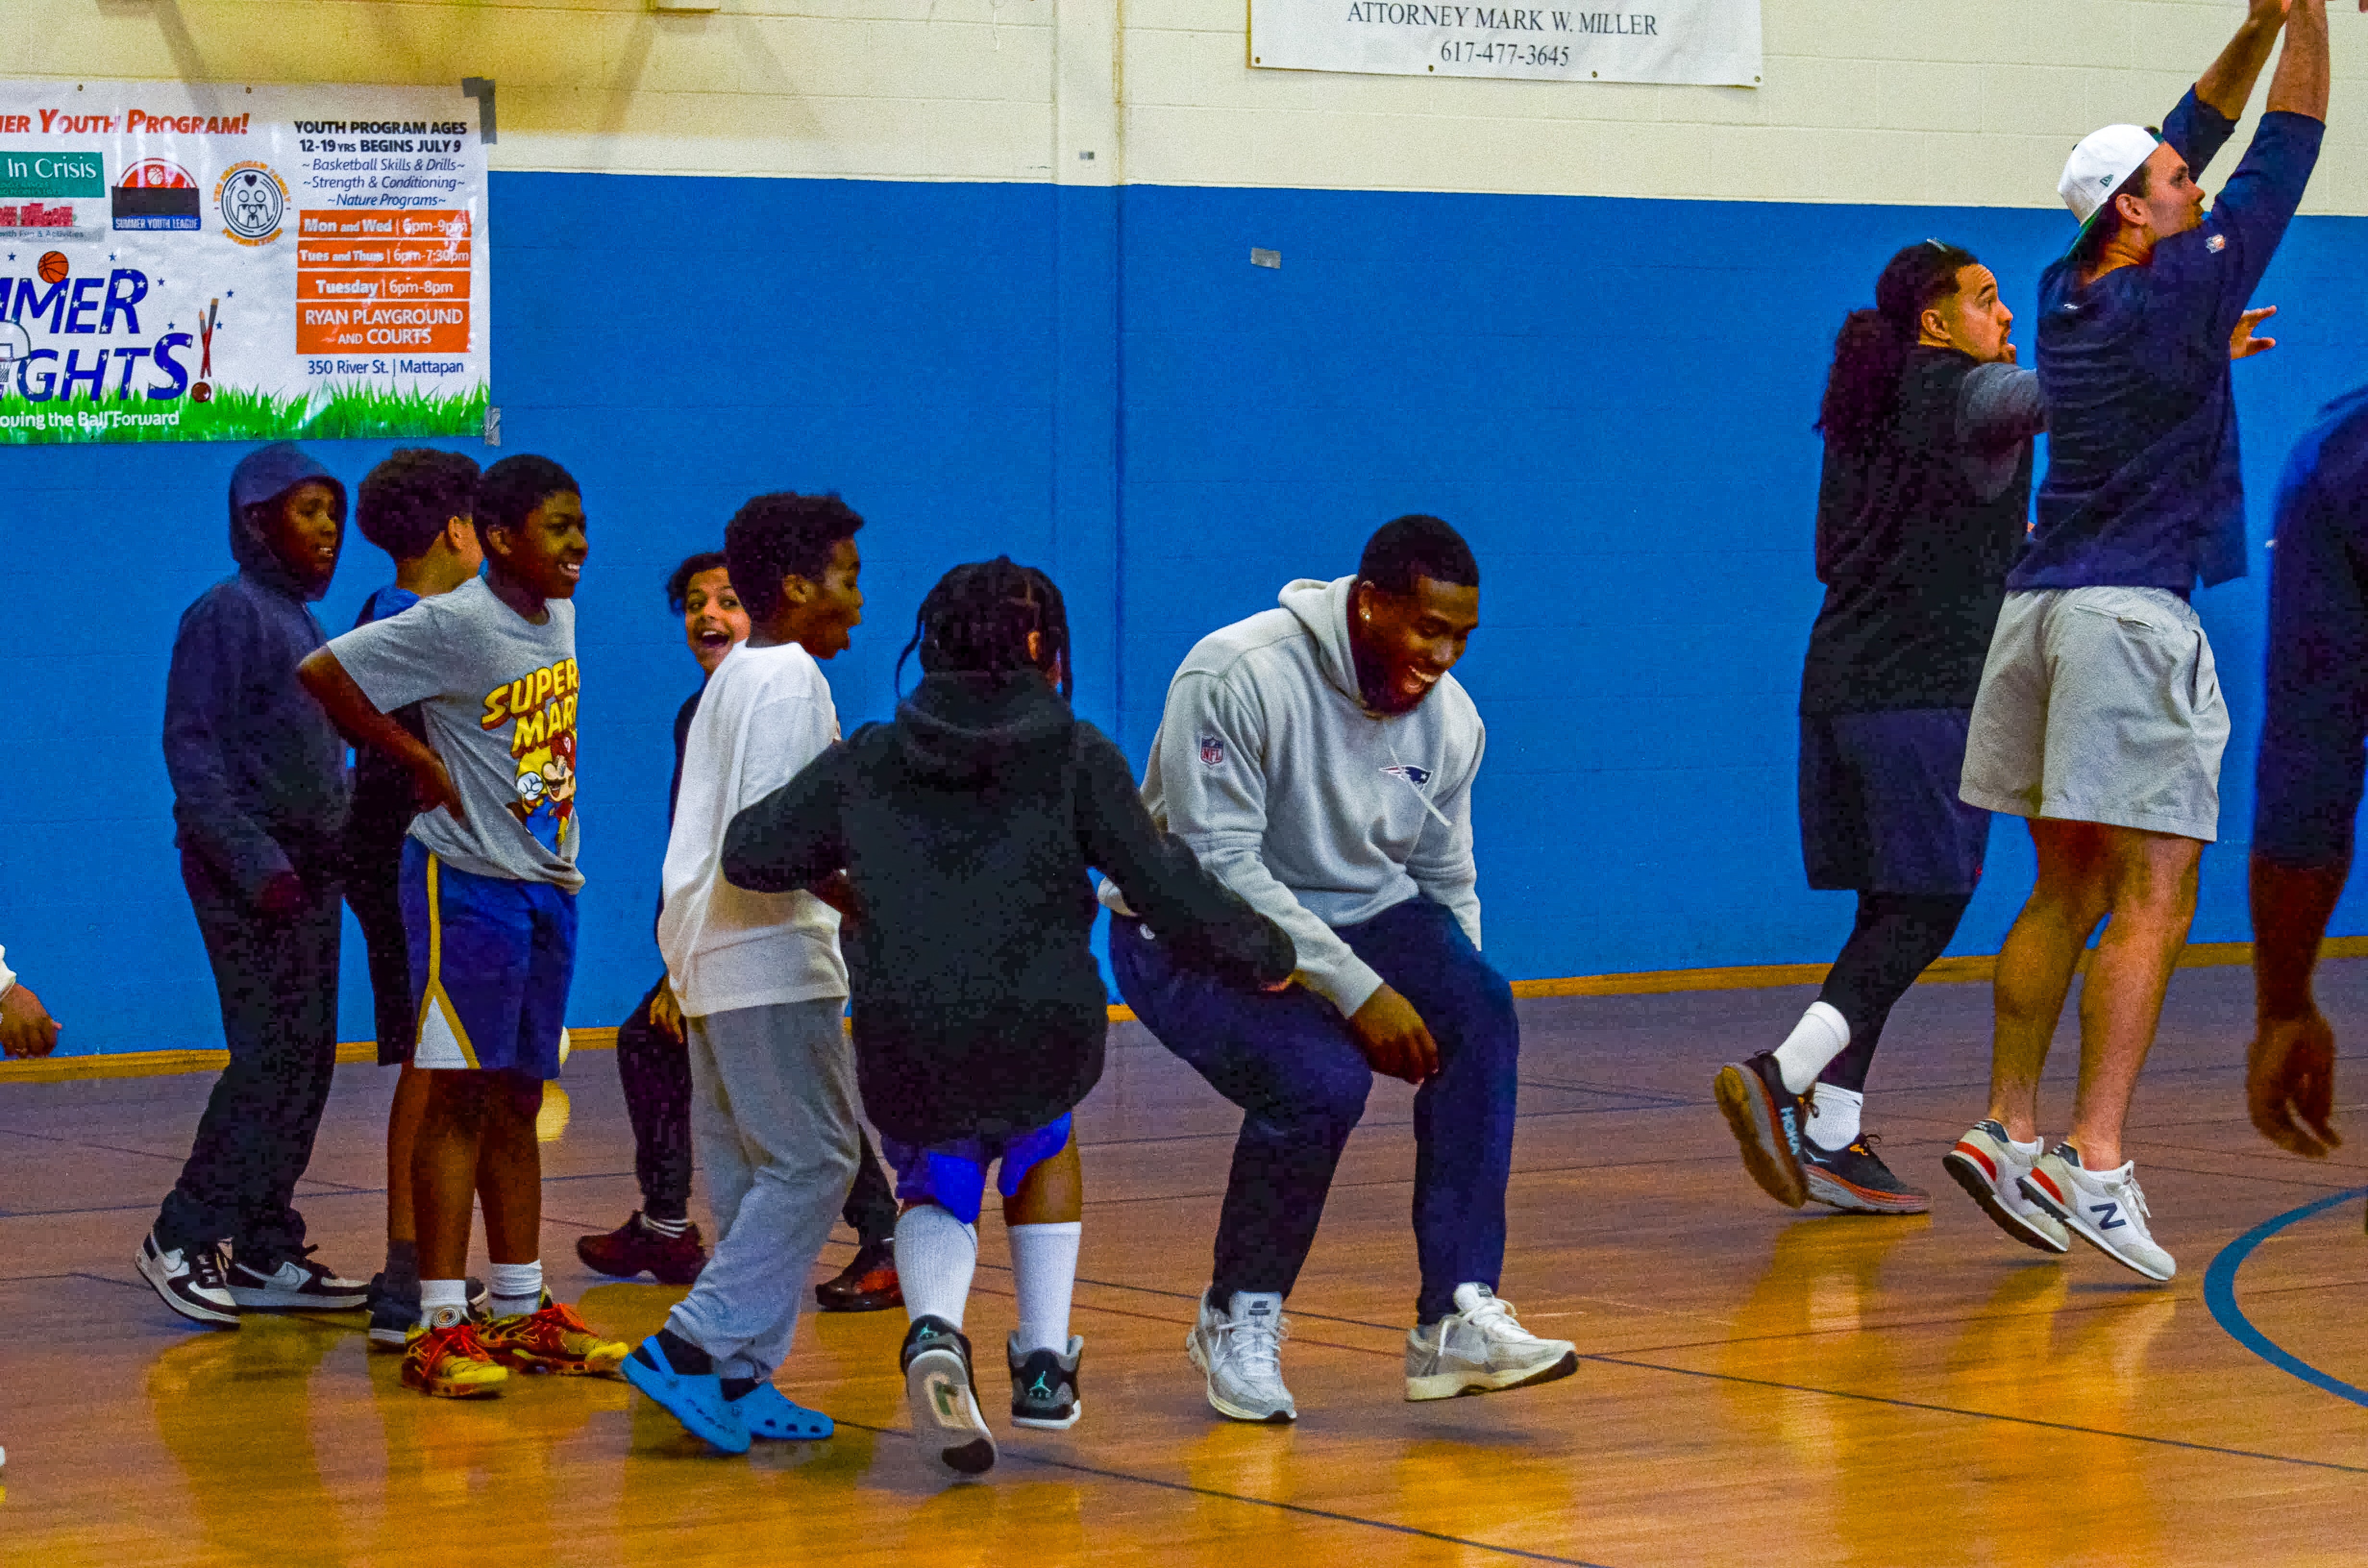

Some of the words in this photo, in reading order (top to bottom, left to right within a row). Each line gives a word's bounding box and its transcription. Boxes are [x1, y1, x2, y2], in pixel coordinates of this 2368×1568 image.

[1347, 1, 1469, 26] ATTORNEY
[1475, 7, 1544, 31] MARK
[1551, 11, 1573, 32] W.
[1579, 12, 1657, 35] MILLER
[1441, 40, 1569, 66] 617-477-3645
[0, 115, 31, 133] ER
[294, 121, 346, 134] YOUTH
[350, 121, 427, 135] PROGRAM
[430, 122, 467, 135] AGES
[299, 139, 336, 152] 12-19
[360, 139, 414, 152] BEGINS
[417, 139, 450, 153] JULY
[454, 139, 461, 152] 9
[8, 158, 27, 178] In
[35, 156, 97, 179] Crisis
[380, 159, 411, 171] Skills
[414, 159, 423, 171] &
[368, 176, 378, 188] &
[147, 218, 171, 229] YOUTH
[303, 218, 337, 232] Mon
[340, 222, 360, 232] and
[362, 219, 393, 232] Wed
[299, 250, 329, 262] Tues
[332, 252, 351, 262] and
[315, 279, 379, 297] Tuesday
[389, 279, 454, 297] 6pm-8pm
[0, 269, 148, 334] MER
[305, 309, 349, 325] RYAN
[353, 309, 464, 325] PLAYGROUND
[338, 333, 363, 344] AND
[367, 328, 432, 345] COURTS
[308, 360, 333, 375] 350
[337, 359, 369, 375] River
[372, 359, 389, 375] St.
[400, 359, 464, 376] Mattapan
[0, 411, 46, 430] oving
[48, 411, 74, 428] the
[109, 410, 180, 428] Forward
[481, 657, 580, 731] SUPER
